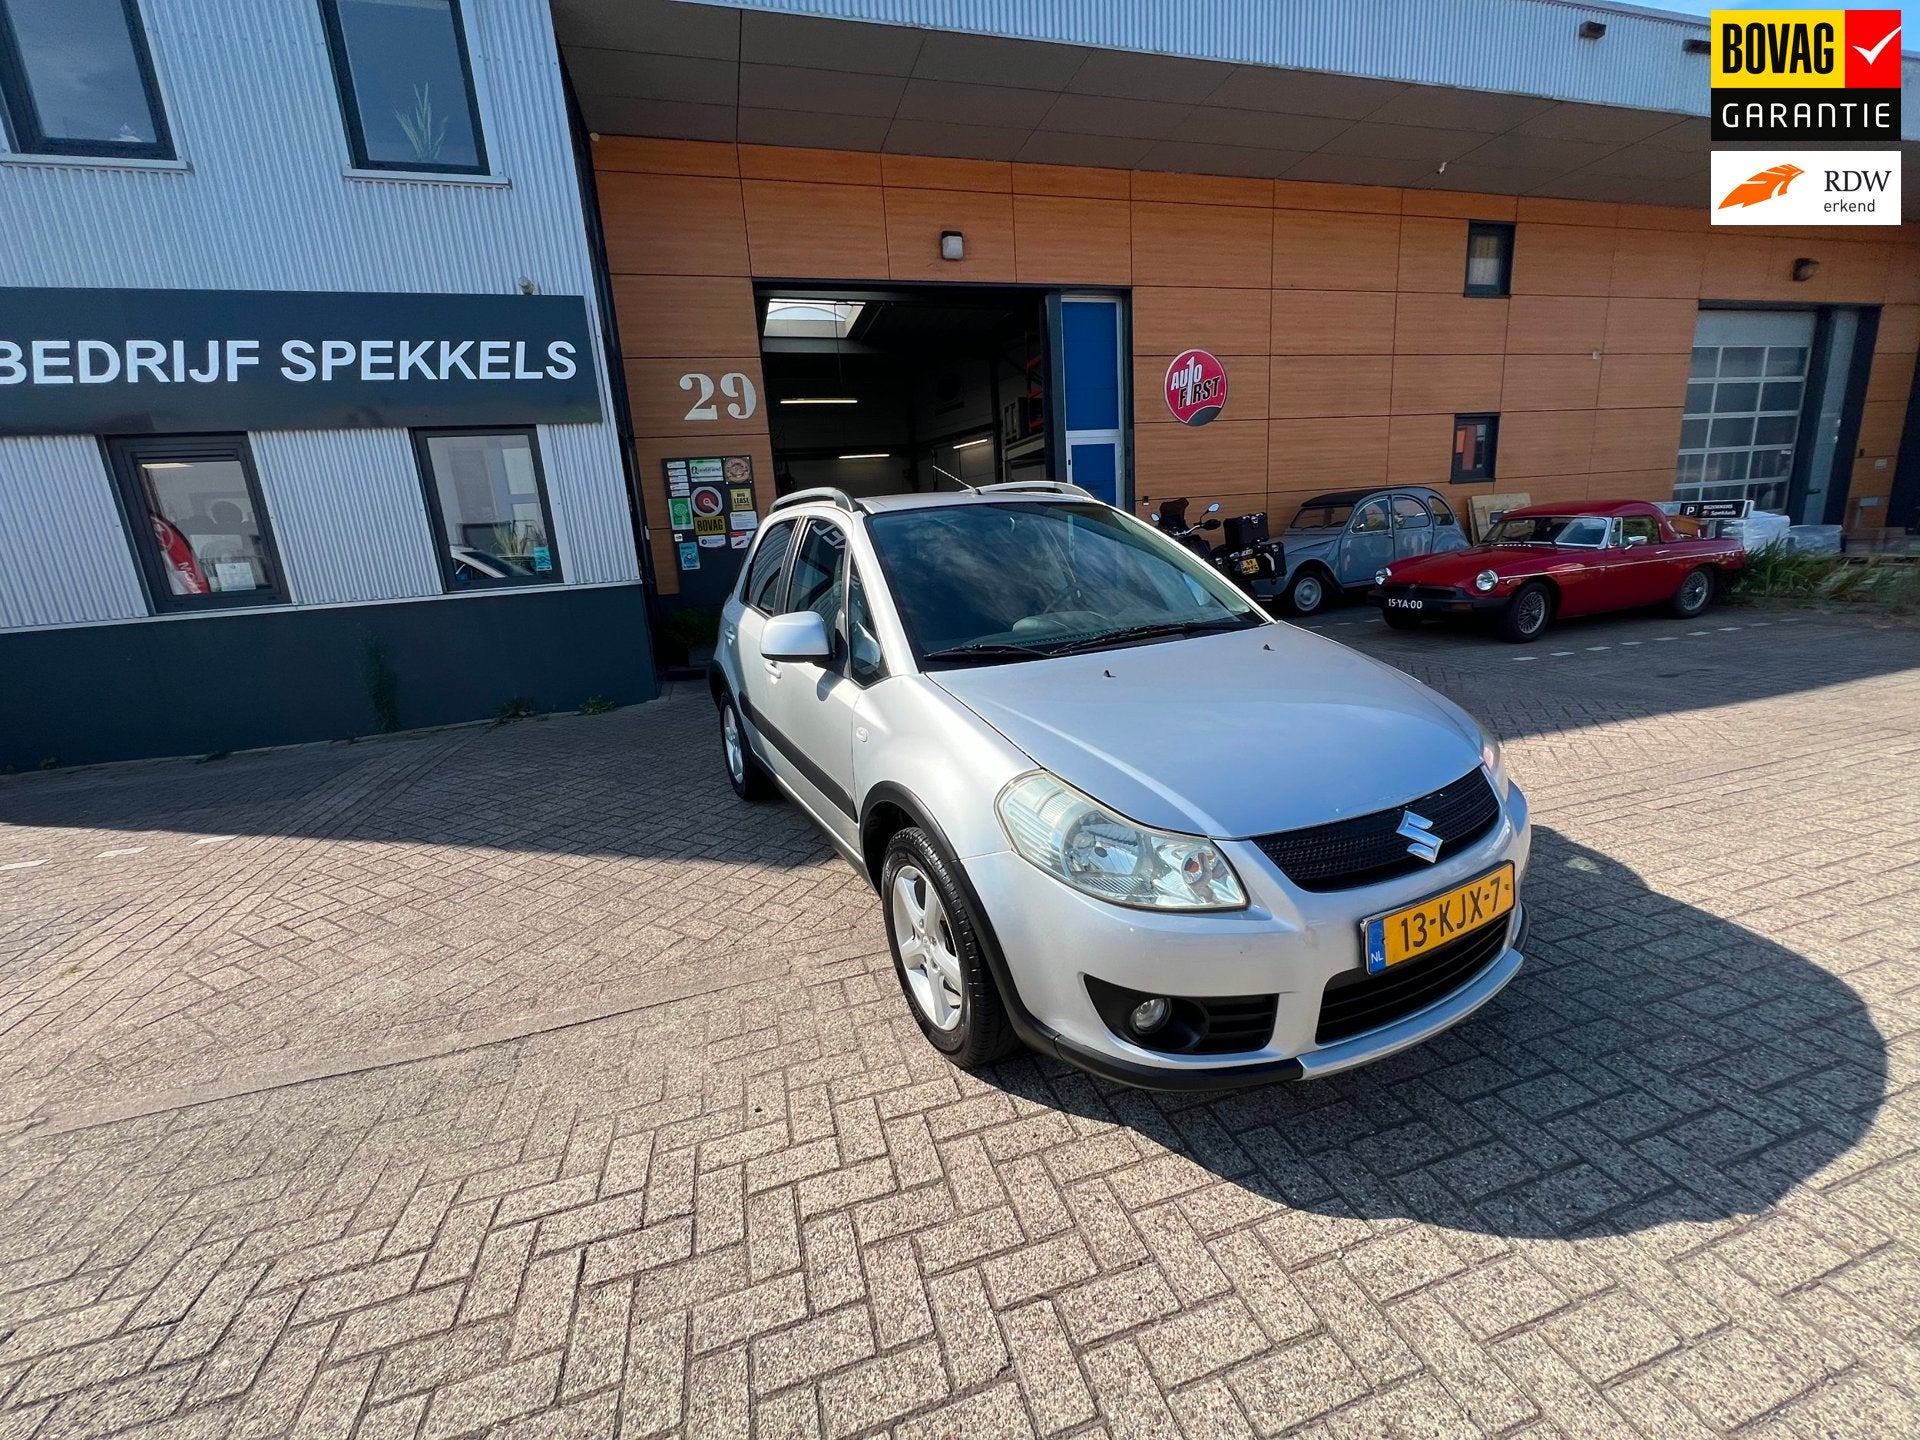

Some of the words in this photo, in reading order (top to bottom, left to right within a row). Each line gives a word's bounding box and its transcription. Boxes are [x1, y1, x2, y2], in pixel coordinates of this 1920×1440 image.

[0, 340, 260, 385] BEDRIJF
[280, 339, 577, 382] SPEKKELS
[679, 372, 757, 420] 29
[697, 518, 723, 532] BOVAG
[1686, 506, 1695, 515] P
[1388, 598, 1423, 609] 15-YA-00
[1371, 952, 1384, 964] NL
[1401, 876, 1501, 952] 13-KJX-7
